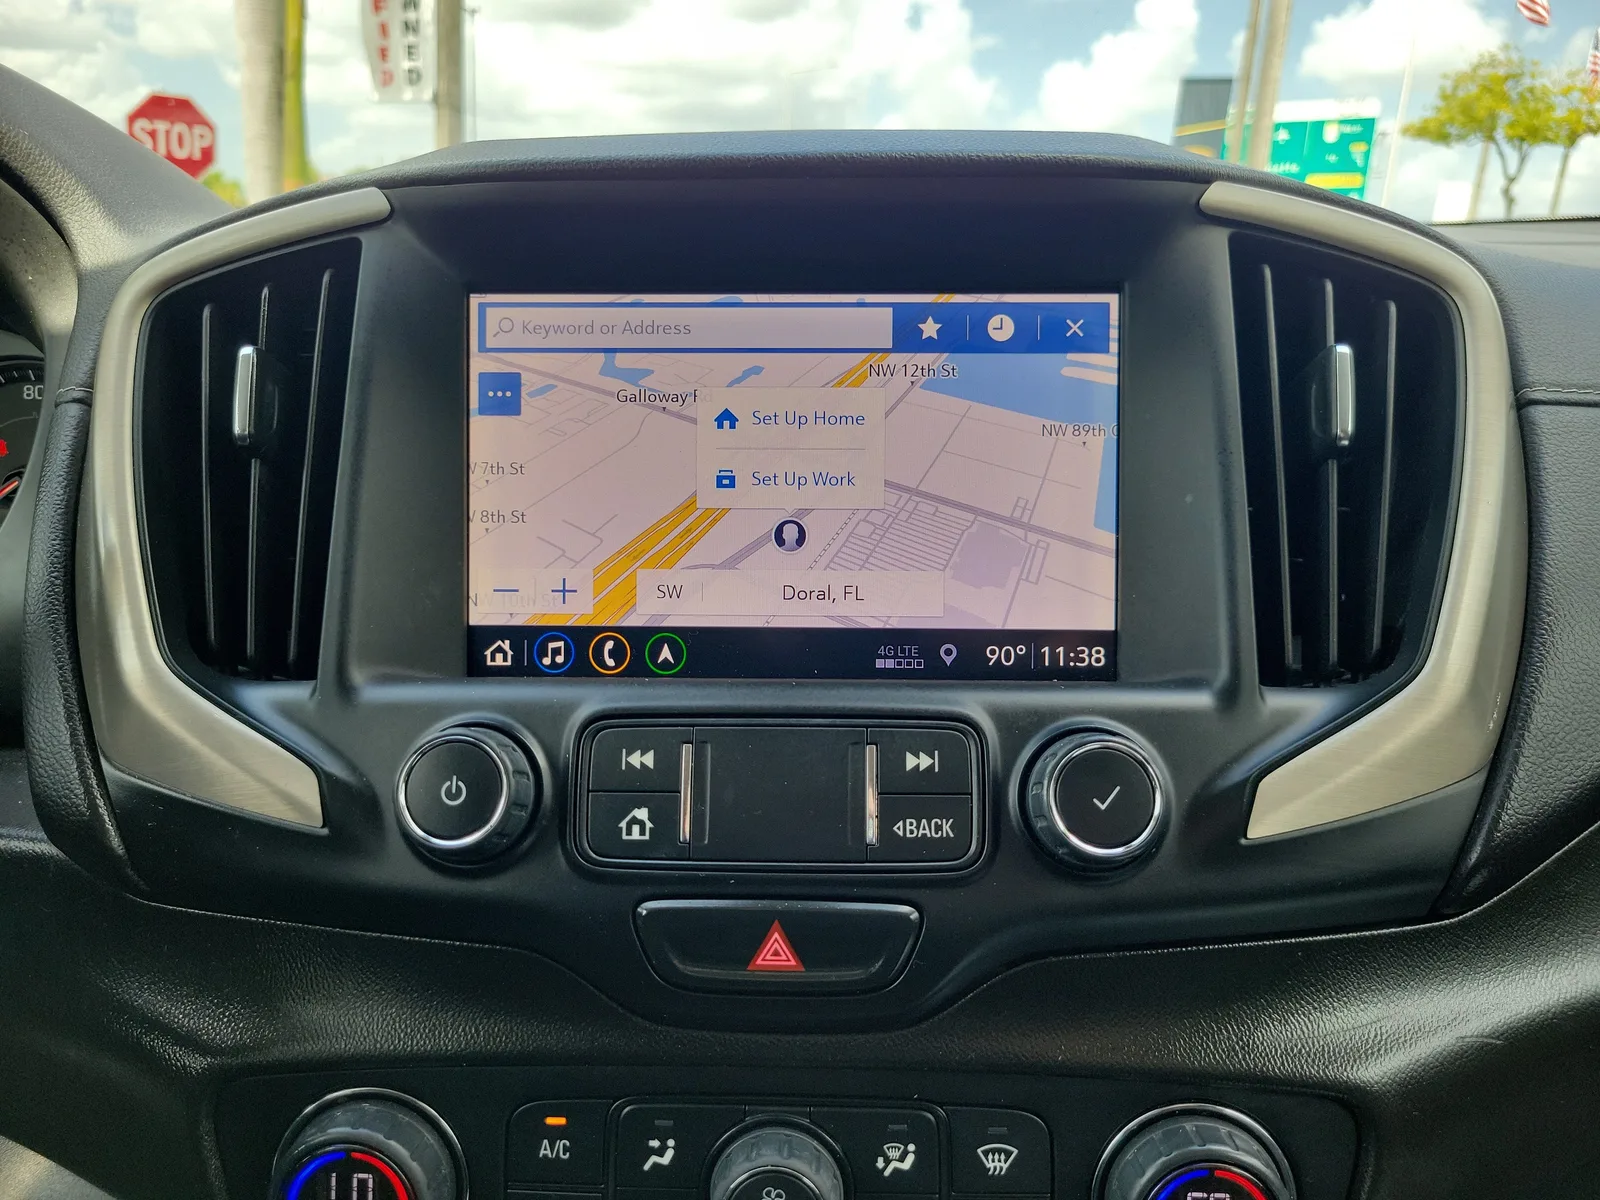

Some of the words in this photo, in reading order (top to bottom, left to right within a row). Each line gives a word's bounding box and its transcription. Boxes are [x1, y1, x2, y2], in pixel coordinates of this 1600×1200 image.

[132, 117, 213, 161] STOP
[521, 319, 594, 340] Keyword
[600, 324, 618, 336] or
[622, 319, 691, 336] Address
[868, 363, 898, 379] NW
[901, 362, 936, 379] 12th
[941, 363, 958, 379] St
[616, 388, 689, 408] Galloway
[752, 410, 779, 427] Set
[784, 410, 809, 431] Up
[814, 410, 866, 427] Home
[1042, 423, 1068, 437] NW
[1072, 423, 1106, 438] 89th
[481, 461, 505, 475] 7th
[509, 461, 525, 476] St
[752, 471, 779, 488] Set
[784, 471, 809, 492] Up
[812, 471, 856, 488] Work
[480, 509, 506, 524] 8th
[510, 509, 527, 524] St
[656, 583, 683, 600] SW
[782, 584, 836, 604] Doral,
[843, 585, 865, 601] FL
[877, 645, 894, 657] 4G
[898, 645, 919, 657] LTE
[985, 645, 1026, 666] 90°
[1040, 646, 1106, 667] 11:38
[905, 818, 954, 839] BACK
[539, 1138, 570, 1160] A/C
